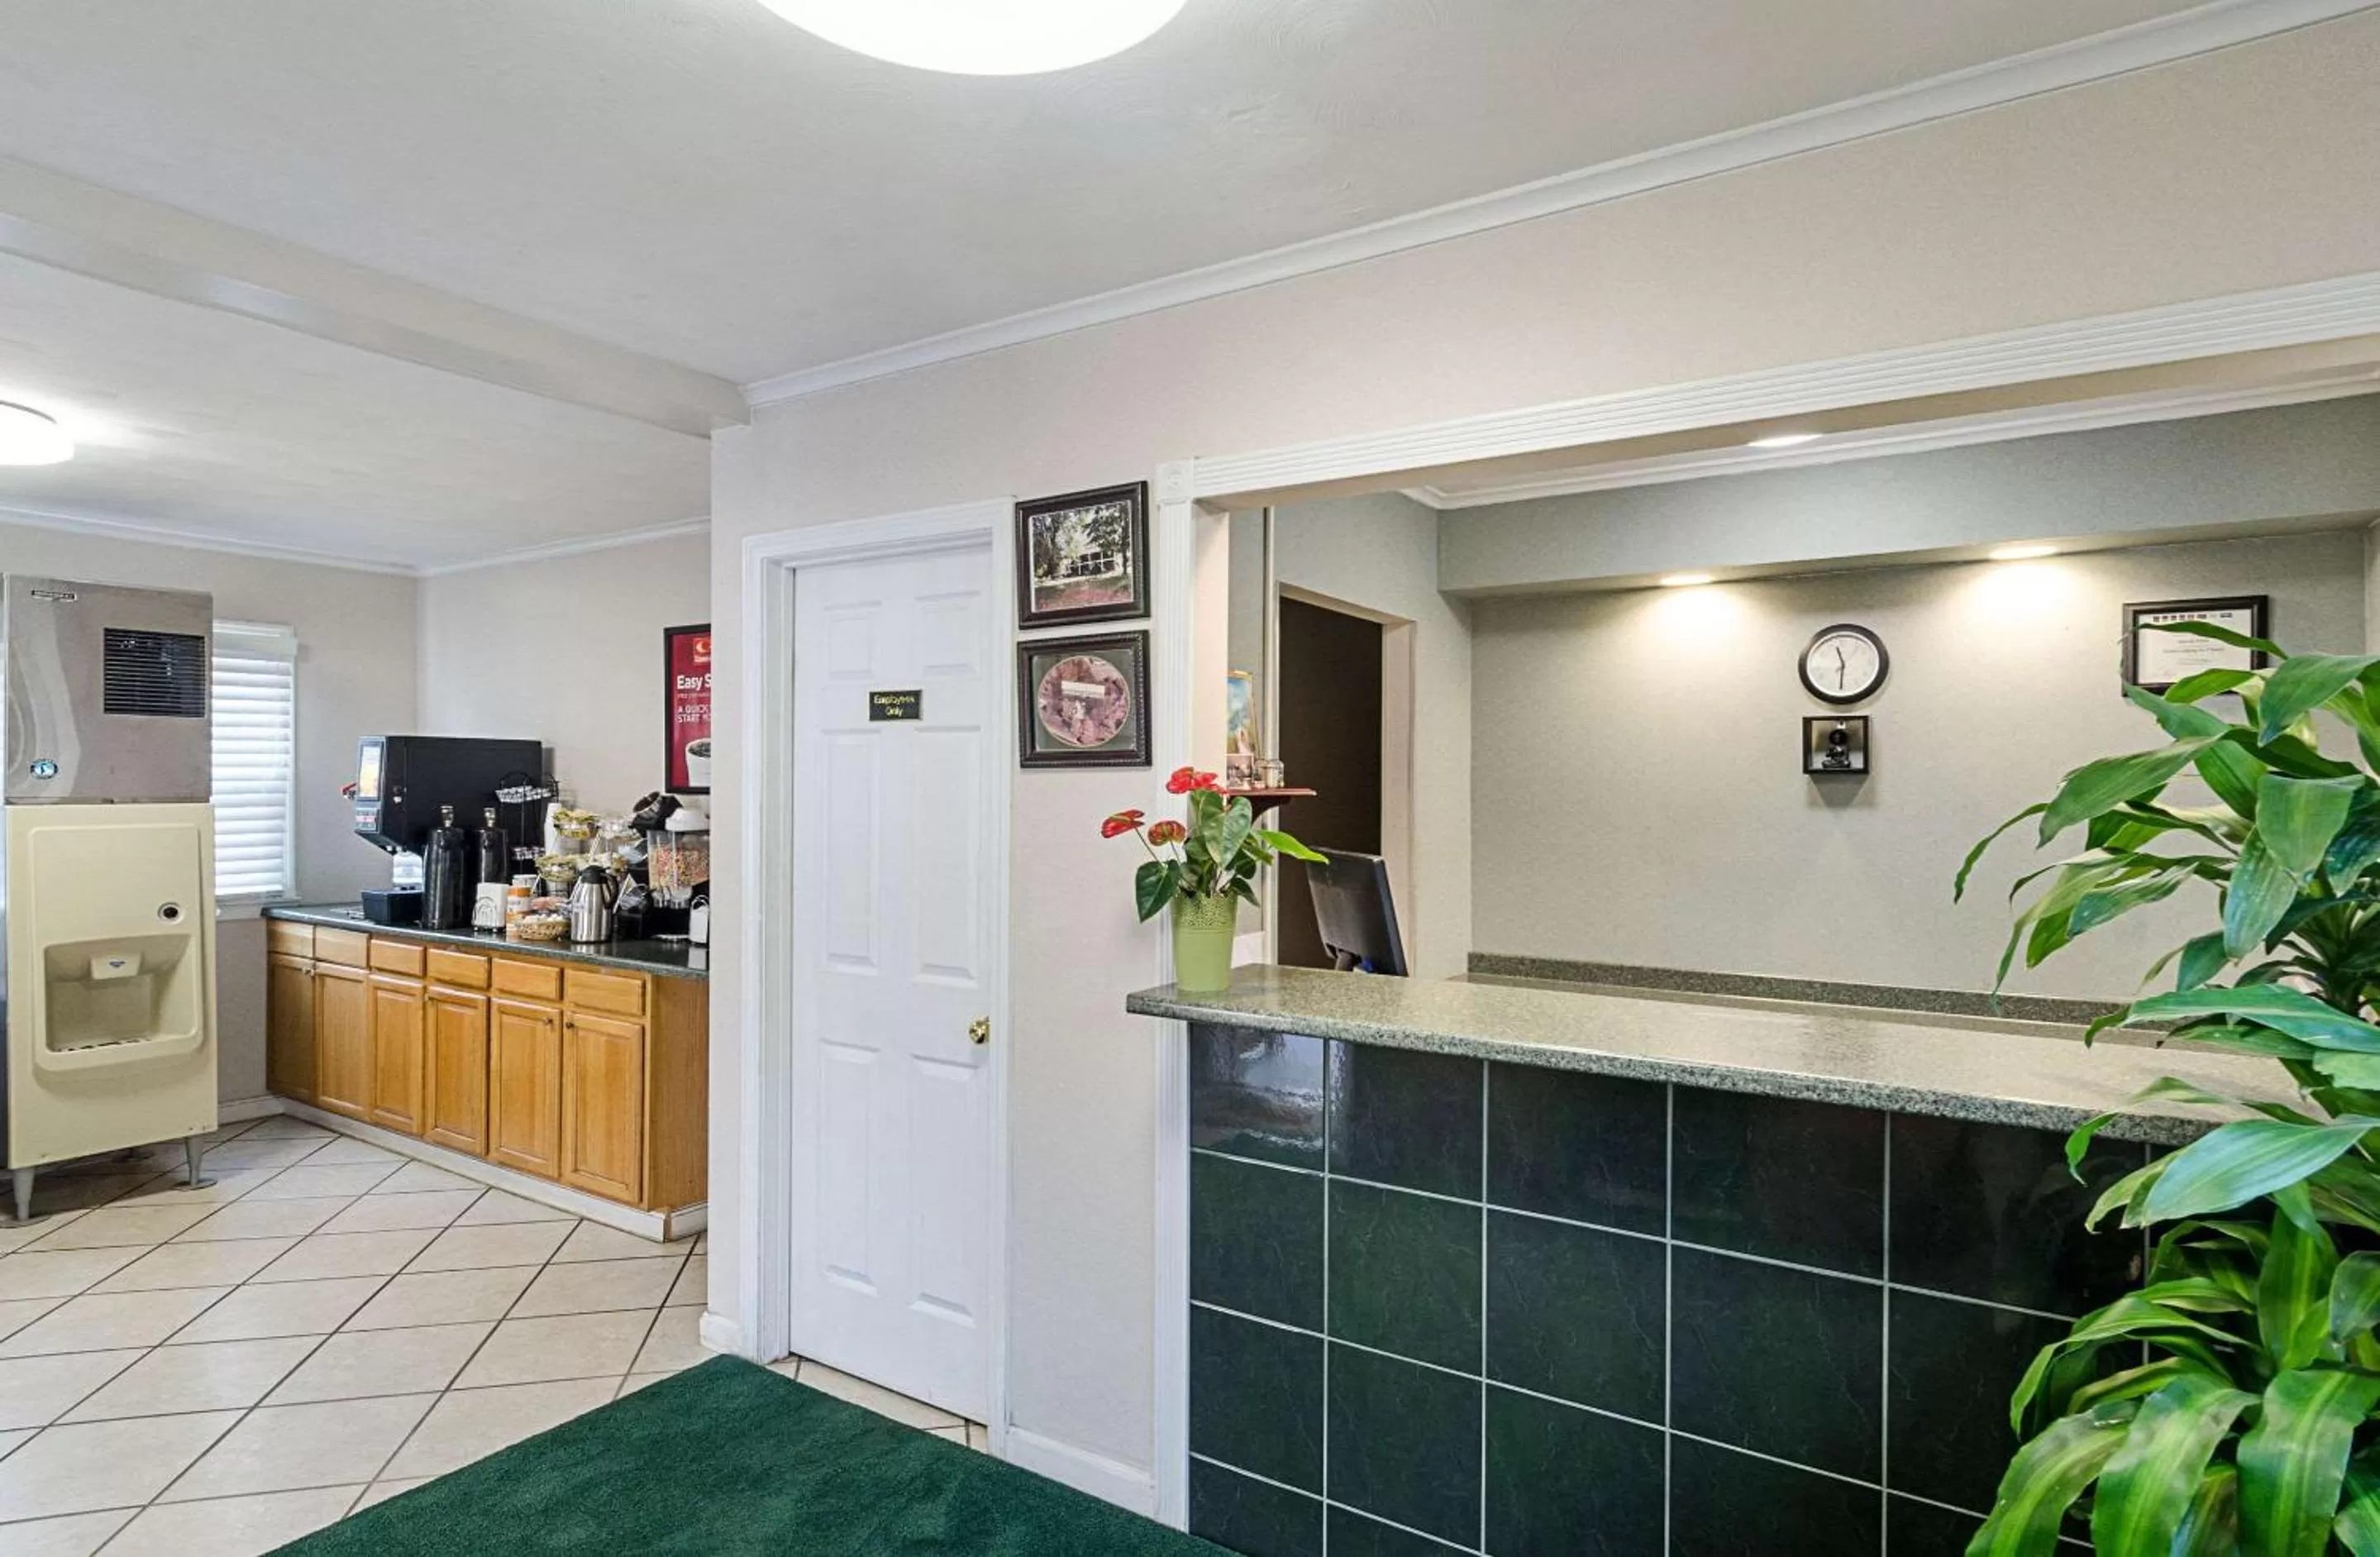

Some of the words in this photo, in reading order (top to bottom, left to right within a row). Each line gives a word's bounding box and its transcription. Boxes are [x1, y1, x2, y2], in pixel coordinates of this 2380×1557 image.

[677, 675, 703, 690] Easy
[874, 695, 914, 704] Employees
[685, 704, 708, 714] QUICK
[885, 706, 903, 718] Only
[678, 714, 700, 723] START
